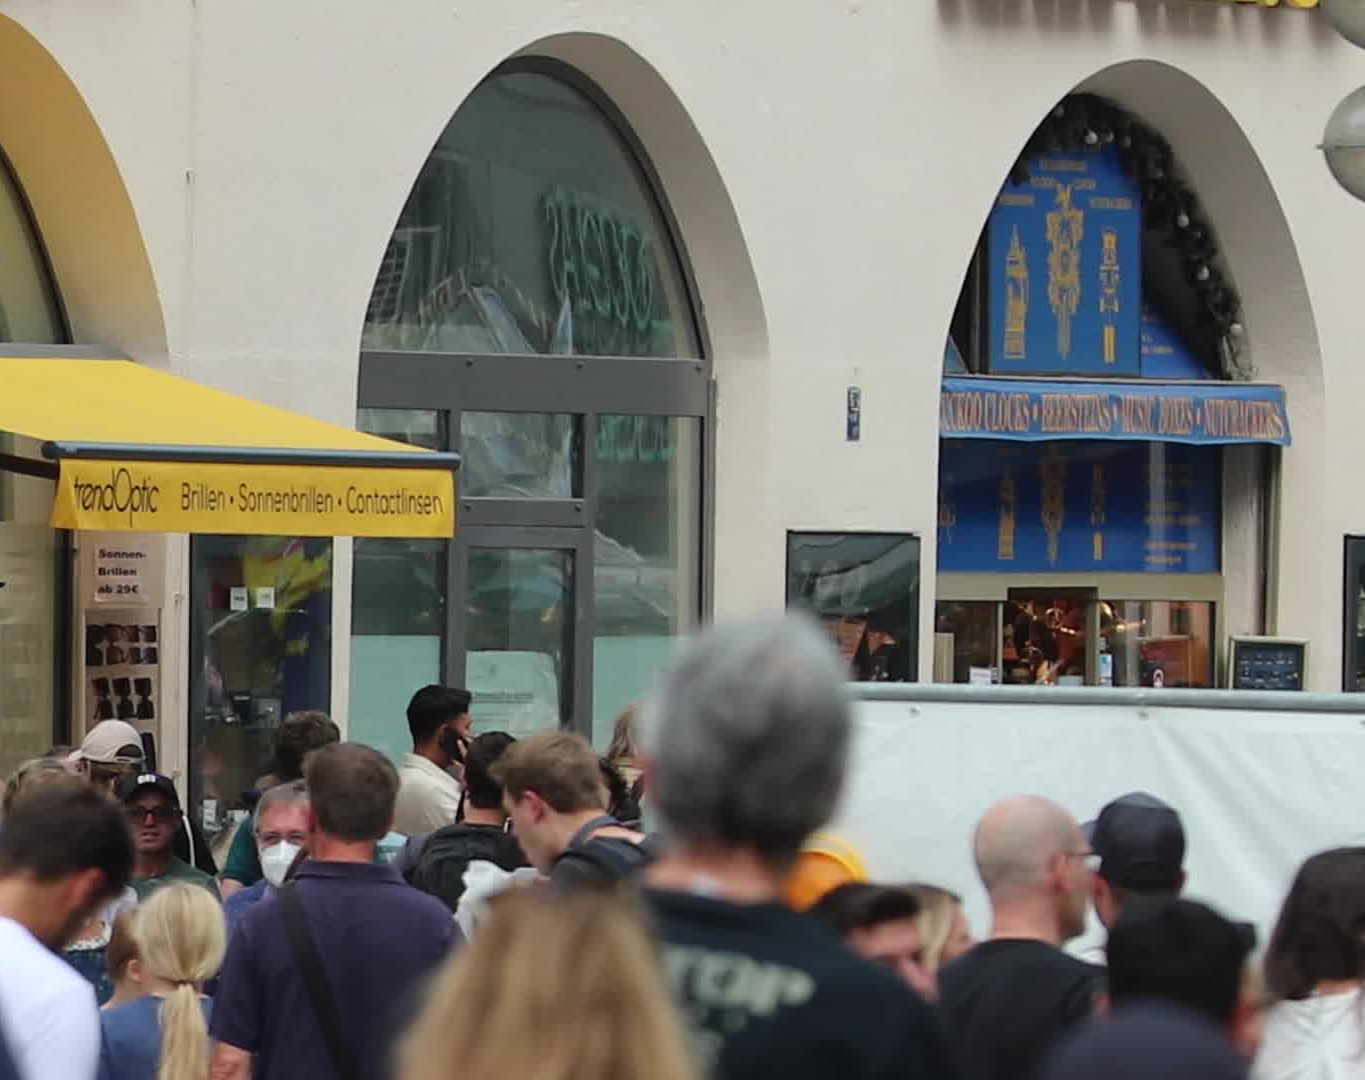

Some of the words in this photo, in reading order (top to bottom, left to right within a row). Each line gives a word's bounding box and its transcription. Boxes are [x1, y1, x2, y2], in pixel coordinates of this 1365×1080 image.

[74, 468, 160, 528] trendOptic
[181, 482, 226, 512] Brillen
[238, 484, 334, 514] Sonnenbrillen
[346, 485, 443, 516] Contactlinsen
[97, 549, 148, 560] Sonnen-
[97, 566, 138, 578] Brillen
[97, 584, 113, 595] ab
[116, 584, 139, 596] 29€
